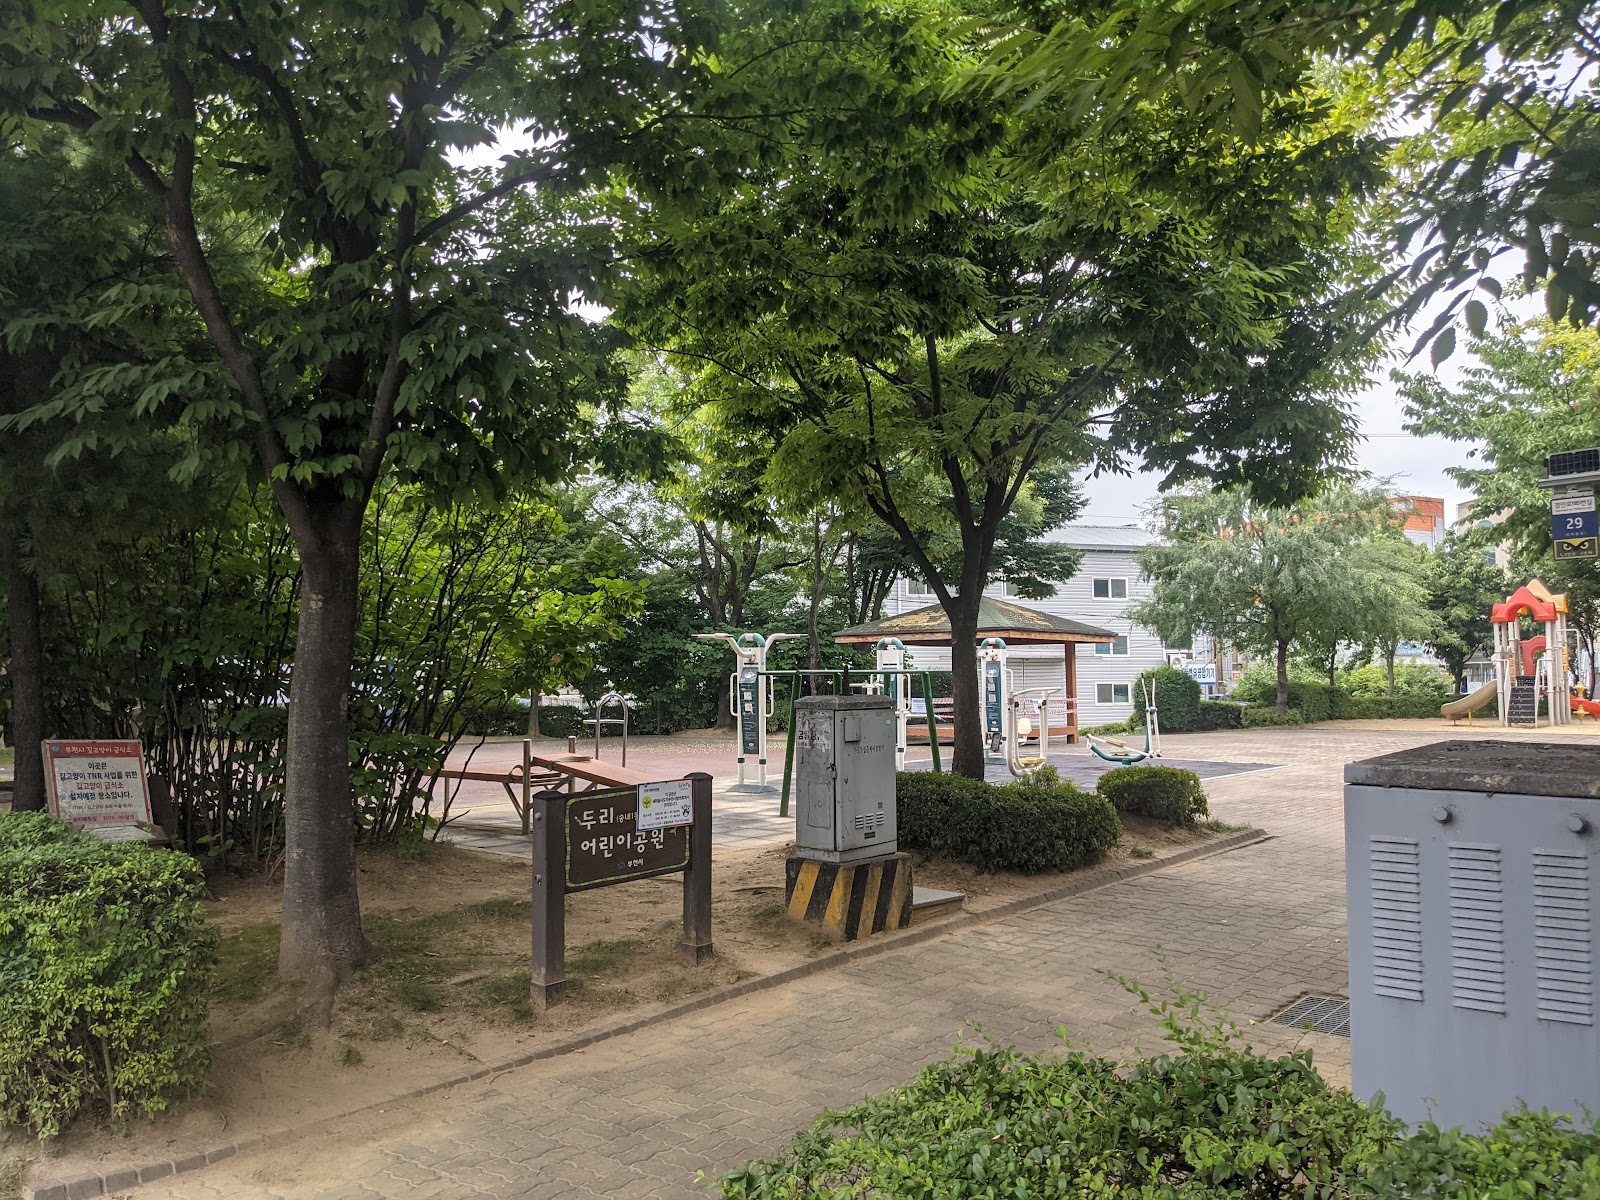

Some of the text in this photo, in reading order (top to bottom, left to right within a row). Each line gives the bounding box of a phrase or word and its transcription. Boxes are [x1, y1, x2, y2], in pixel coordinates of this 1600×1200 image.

[1566, 517, 1583, 530] 29
[86, 746, 112, 754] 길고양이
[88, 762, 108, 770] 이곳은
[59, 772, 86, 780] 길고양이
[104, 771, 123, 779] 사업을
[124, 771, 138, 779] 위한
[76, 782, 124, 790] 길고양이 급식소
[581, 807, 614, 830] 두리
[581, 828, 664, 858] 어린이공원
